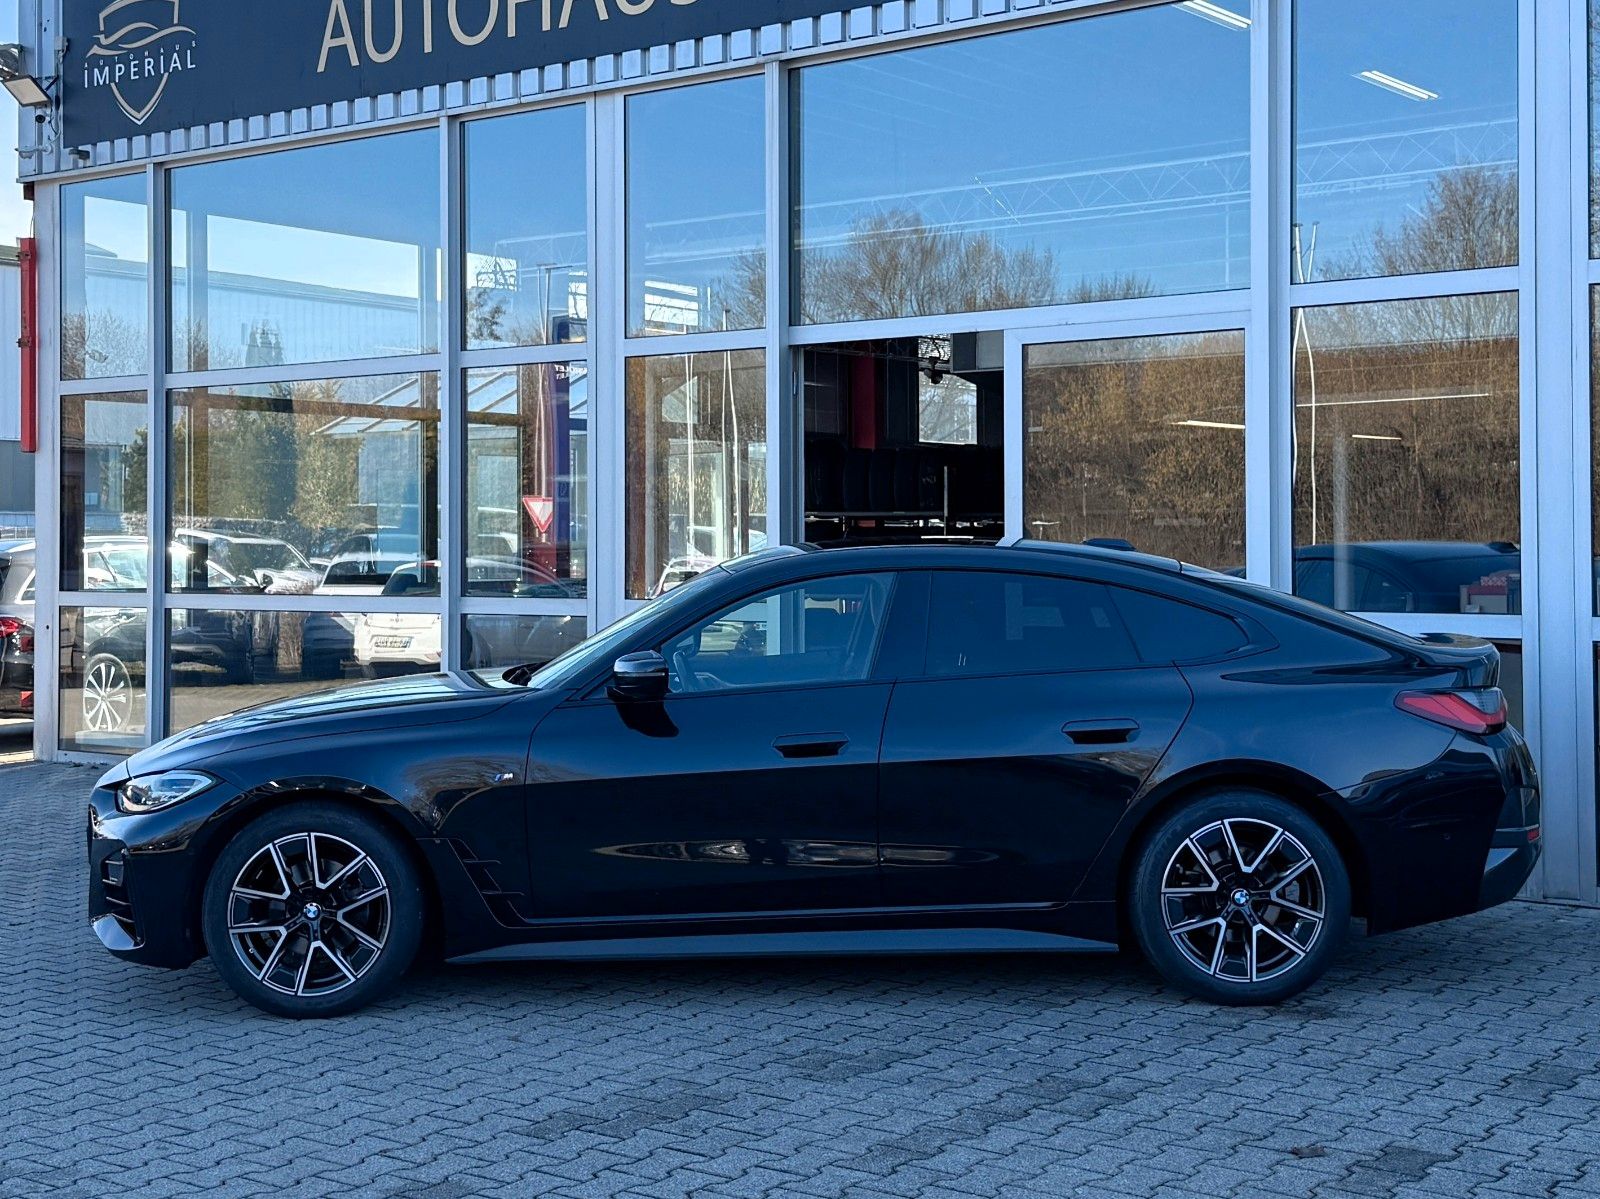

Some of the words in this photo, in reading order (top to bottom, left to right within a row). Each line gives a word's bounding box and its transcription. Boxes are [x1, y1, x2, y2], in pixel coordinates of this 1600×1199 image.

[84, 40, 196, 67] AUTOHAUS
[317, 0, 698, 73] AUTOH
[84, 49, 197, 88] IMPERIAL
